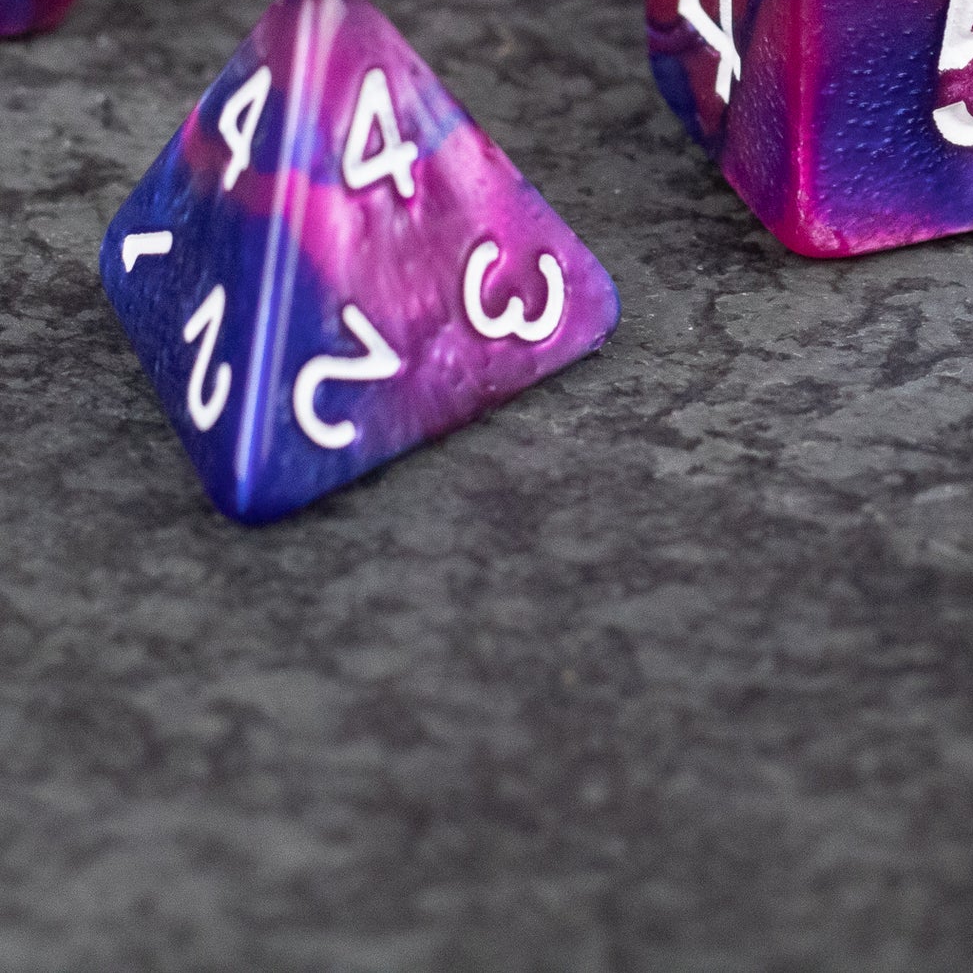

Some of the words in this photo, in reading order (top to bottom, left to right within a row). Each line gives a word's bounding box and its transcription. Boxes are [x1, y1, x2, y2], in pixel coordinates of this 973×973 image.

[217, 65, 274, 192] 4
[341, 67, 420, 199] 4
[182, 284, 234, 432] 2
[463, 240, 566, 344] 3
[292, 303, 403, 451] 2
